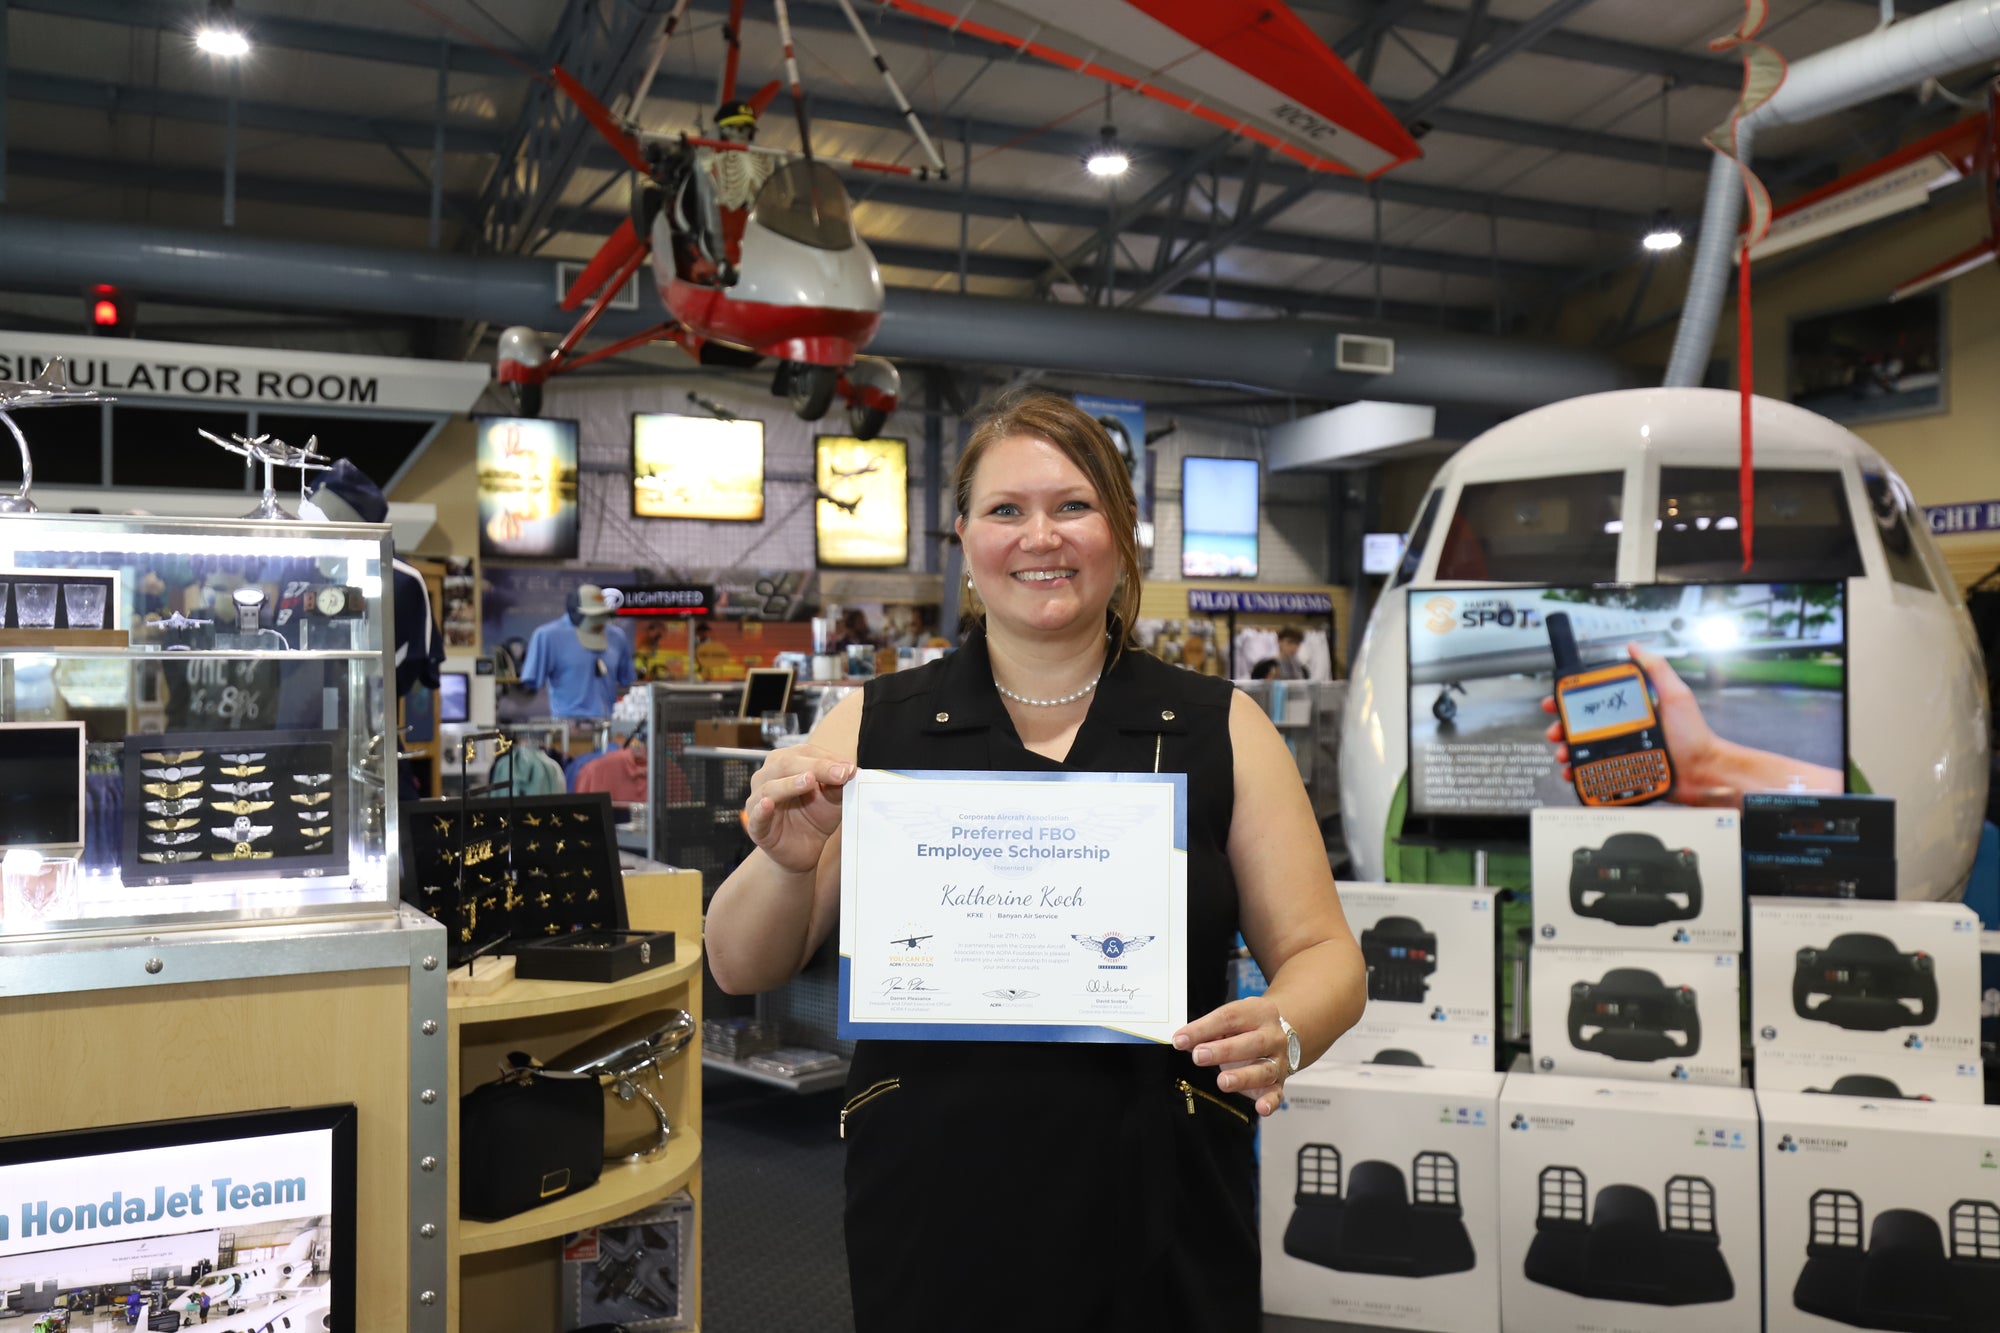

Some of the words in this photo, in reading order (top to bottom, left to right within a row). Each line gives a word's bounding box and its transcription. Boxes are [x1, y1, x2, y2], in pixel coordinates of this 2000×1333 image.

[257, 371, 379, 403] ROOM
[1928, 505, 1983, 533] GHT
[625, 590, 704, 606] LIGHTSPEED
[1190, 591, 1239, 610] PILOT
[1244, 592, 1333, 611] UNIFORMS
[1447, 743, 1499, 753] connected
[1501, 743, 1511, 753] to
[1508, 755, 1554, 764] whenever
[1455, 765, 1491, 775] outside
[1492, 765, 1503, 775] of
[1523, 767, 1551, 777] range
[1484, 776, 1504, 785] with
[1505, 776, 1534, 786] direct
[958, 813, 996, 821] Corporate
[997, 813, 1025, 821] Aircraft
[1026, 814, 1069, 822] Association
[951, 826, 1033, 840] Preferred
[1039, 827, 1076, 841] FBO
[917, 843, 1003, 861] Employee
[1008, 845, 1111, 862] Scholarship
[993, 864, 1025, 872] Presented
[941, 884, 1033, 906] Katherine
[1039, 885, 1086, 907] Koch
[998, 912, 1022, 920] Banyan
[989, 932, 1004, 940] June
[1109, 940, 1117, 948] C
[21, 1184, 204, 1238] HondaJet
[211, 1176, 307, 1212] Team
